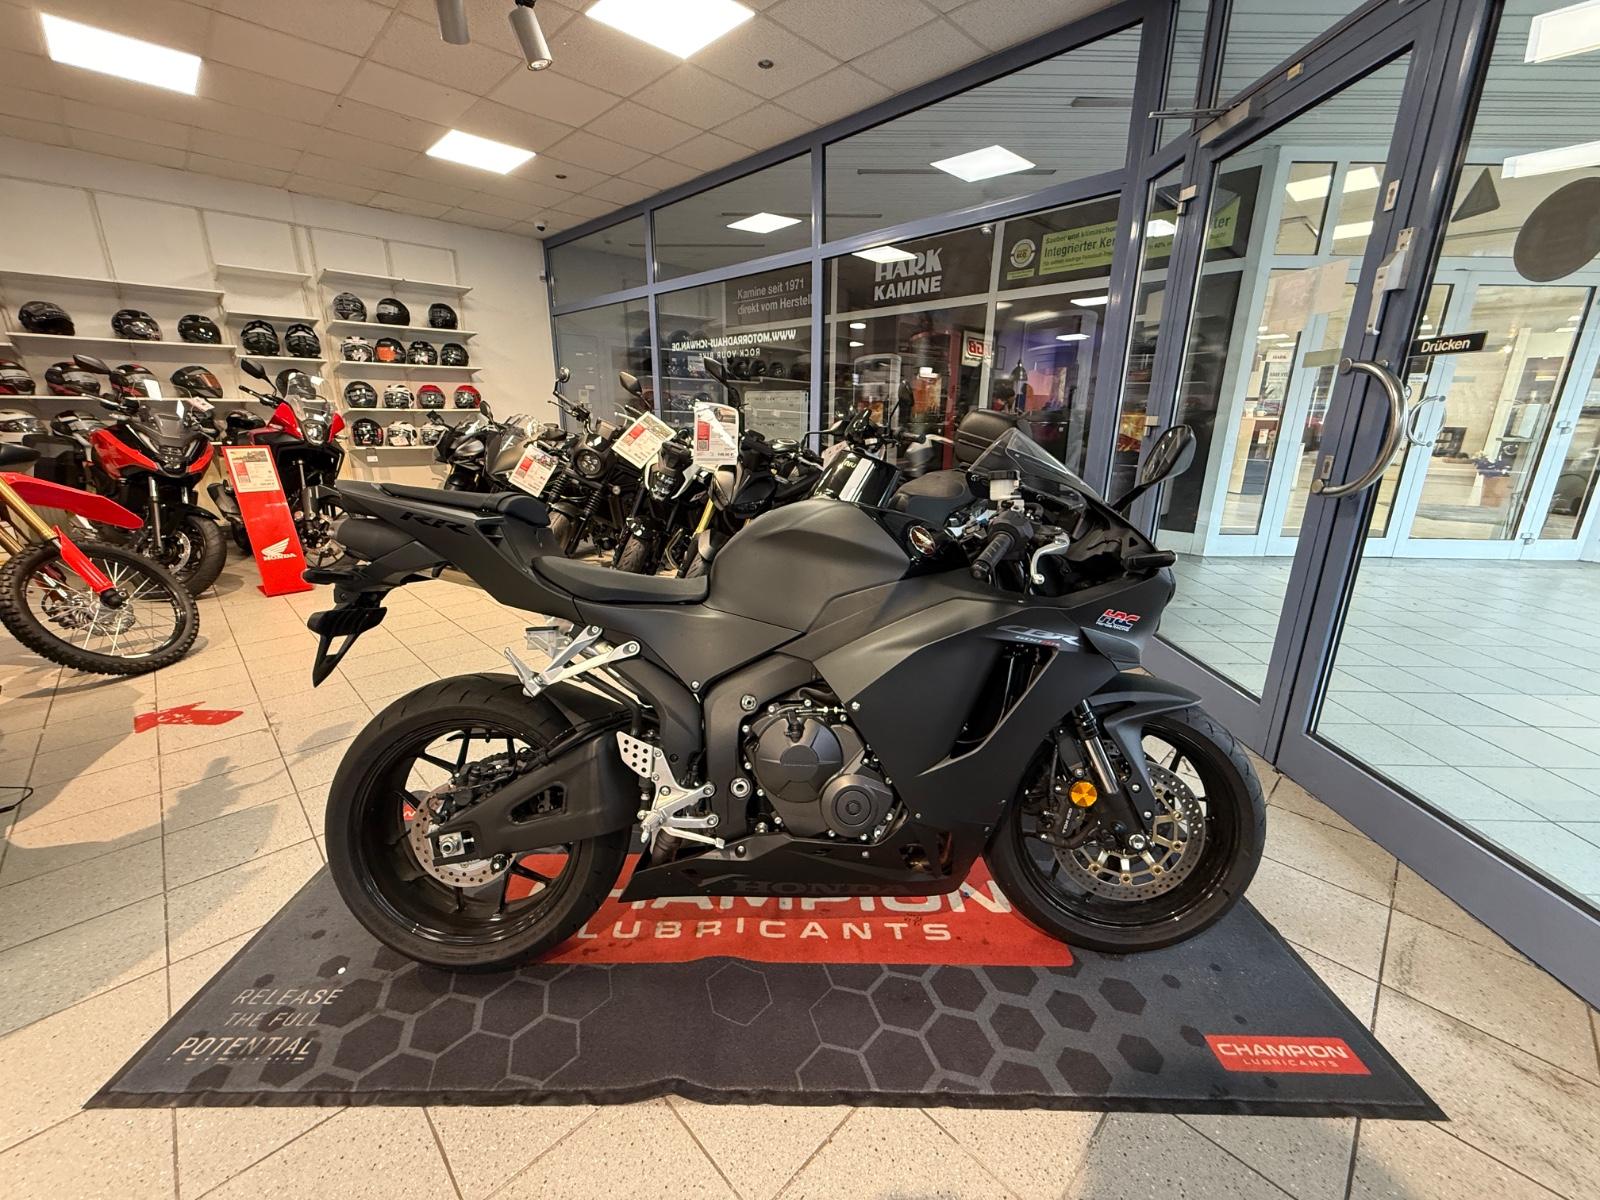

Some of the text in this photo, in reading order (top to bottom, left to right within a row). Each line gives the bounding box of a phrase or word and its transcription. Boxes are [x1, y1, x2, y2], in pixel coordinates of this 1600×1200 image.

[1044, 240, 1097, 258] Integrierter
[874, 248, 943, 282] HARK
[737, 278, 805, 300] Kamine seit 1971
[873, 275, 942, 301] KAMINE
[737, 301, 760, 315] direkt
[761, 300, 778, 312] vom
[1420, 339, 1471, 353] Drücken
[263, 552, 298, 561] HONDA
[733, 879, 911, 895] HONDA
[576, 917, 951, 941] LUBRICANTS
[231, 988, 344, 1005] RELEASE
[223, 1012, 322, 1028] THE FULL
[171, 1036, 316, 1055] POTENTIAL
[1215, 1042, 1350, 1060] CHAMPION
[1242, 1058, 1339, 1068] LUBRICANTS
